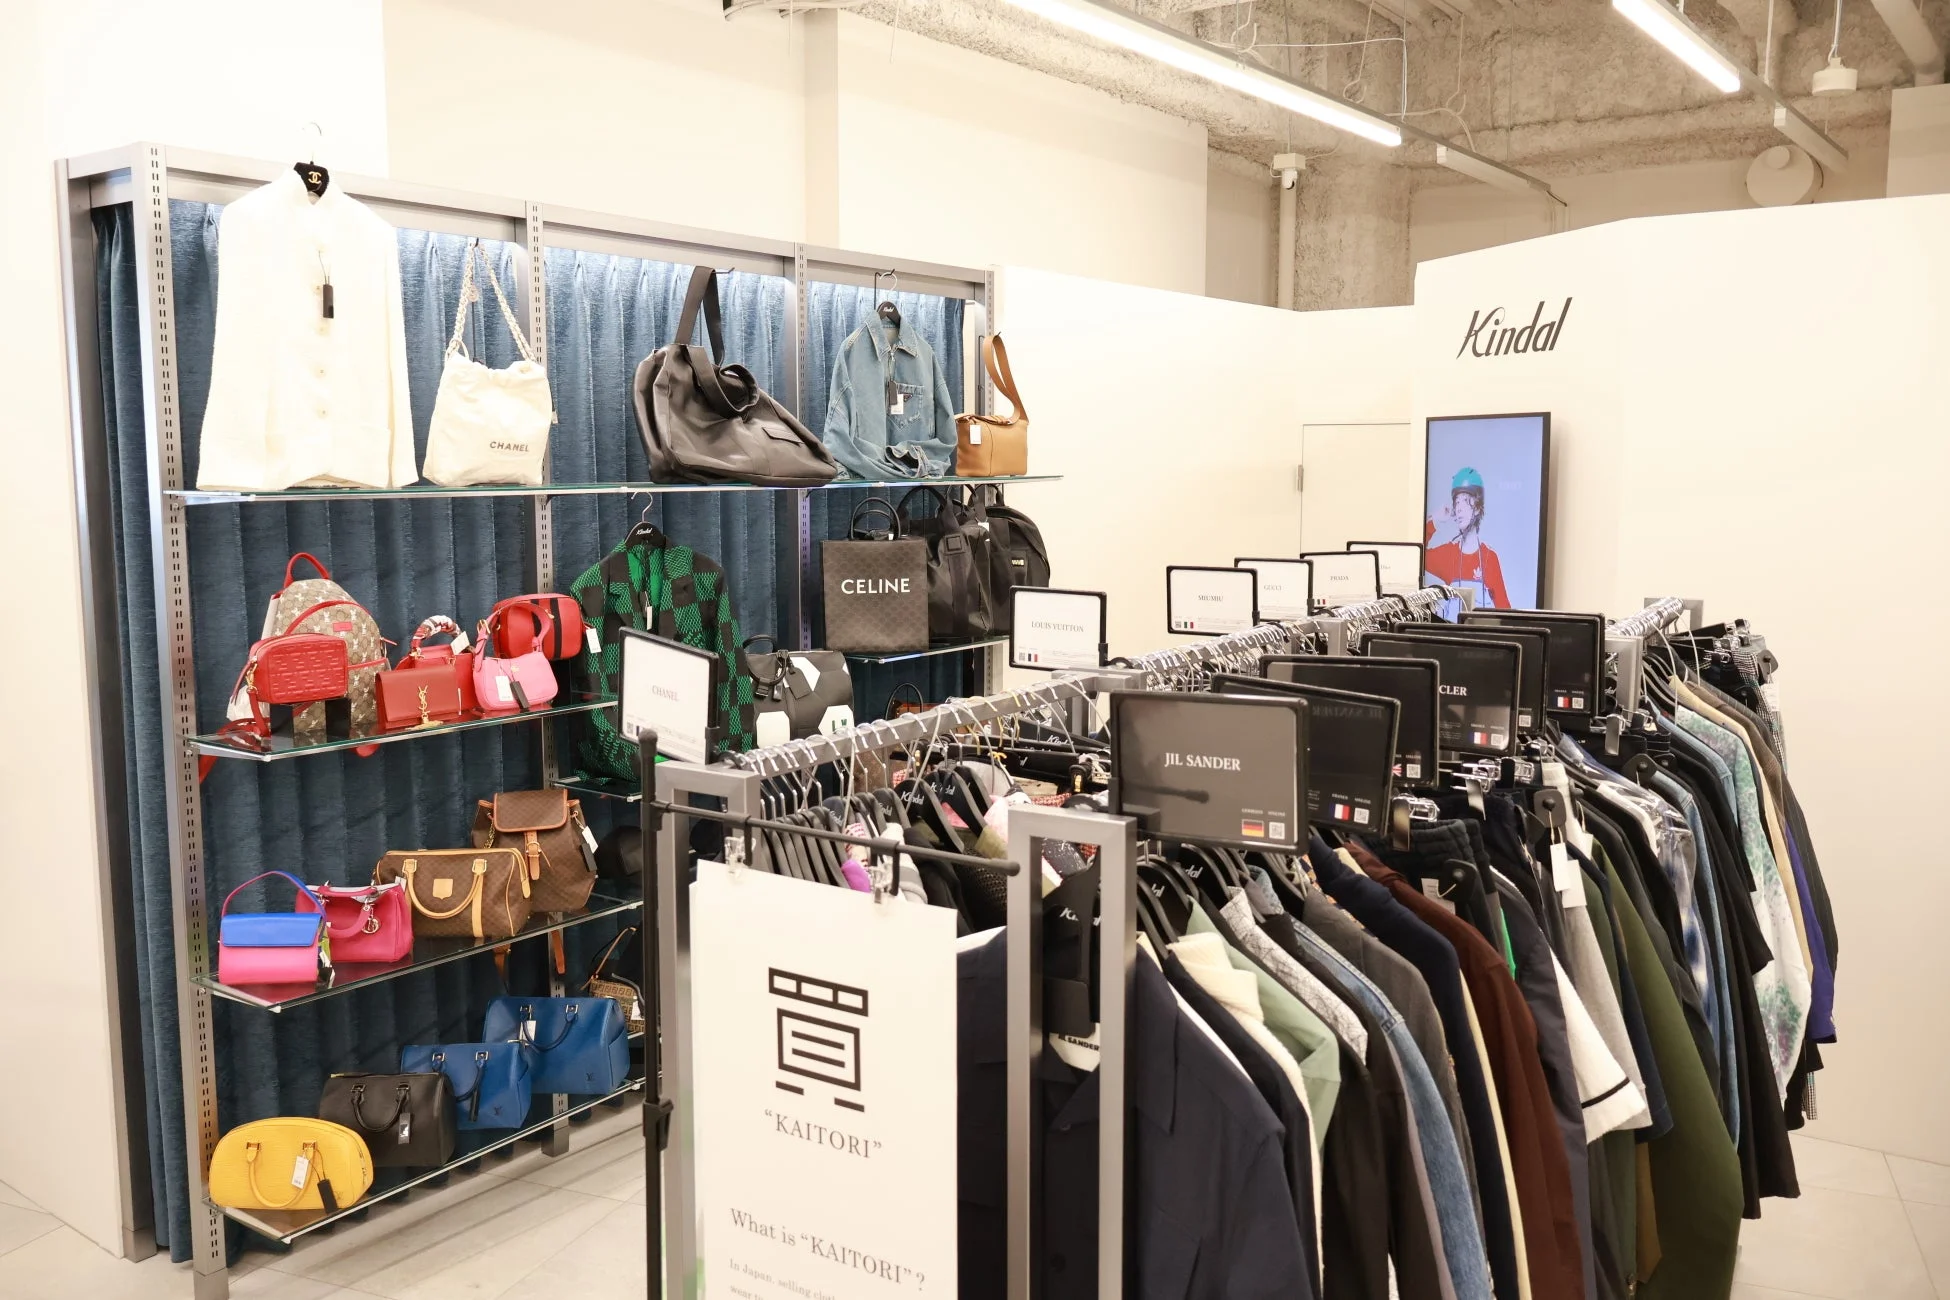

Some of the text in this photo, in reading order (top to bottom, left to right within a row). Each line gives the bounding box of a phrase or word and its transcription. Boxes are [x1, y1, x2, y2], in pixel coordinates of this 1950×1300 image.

[1456, 296, 1573, 360] Kindal
[490, 441, 530, 452] CHANEL
[841, 578, 911, 595] CELINE
[1031, 620, 1052, 630] LOUIS
[651, 684, 678, 702] CHANEL
[1439, 684, 1467, 696] CLER
[1164, 752, 1241, 771] JIL SANDER
[730, 1207, 777, 1240] What
[781, 1225, 796, 1247] is
[730, 1257, 740, 1272] In
[778, 1279, 811, 1299] selling
